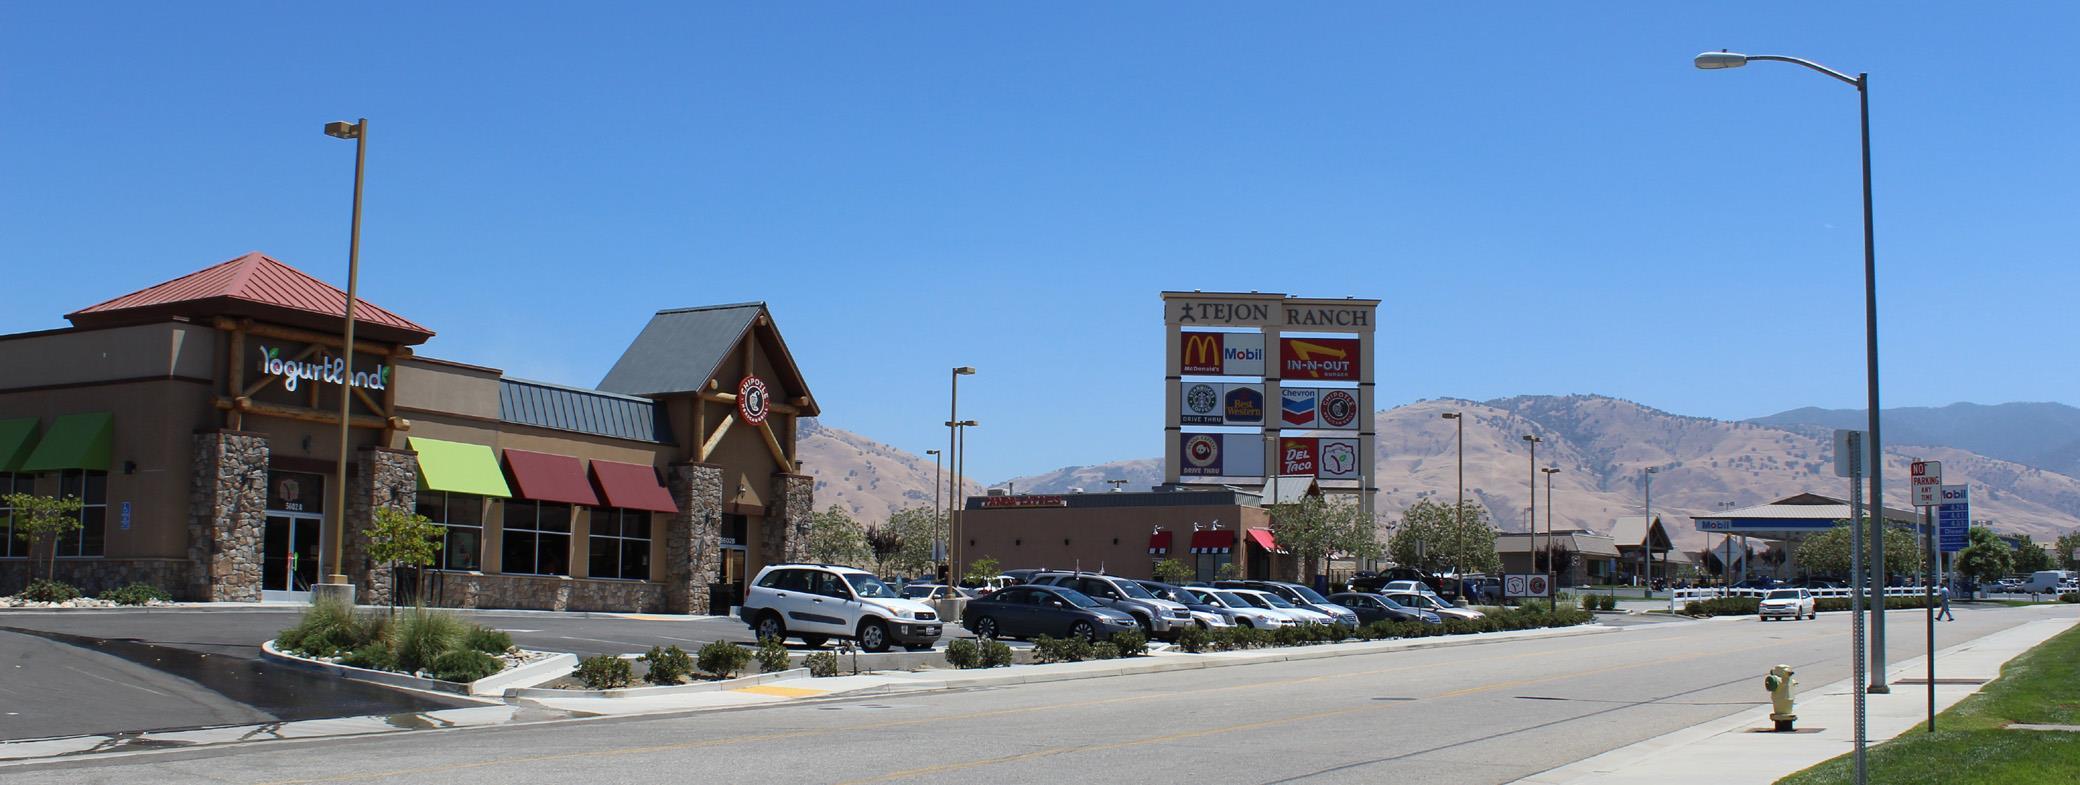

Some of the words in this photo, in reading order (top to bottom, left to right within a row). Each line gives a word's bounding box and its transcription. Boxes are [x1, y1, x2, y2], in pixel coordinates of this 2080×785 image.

[1197, 303, 1269, 323] TEJON
[1286, 308, 1368, 327] RANCH
[1224, 348, 1262, 360] Mobil
[1287, 360, 1350, 371] IN-N-OUT
[741, 378, 769, 400] CHIPOTLE
[1281, 389, 1315, 397] Chevron
[1234, 399, 1253, 408] Best
[1322, 392, 1355, 406] CHIPOTLE
[1226, 406, 1260, 416] Western
[1286, 449, 1310, 461] DEL
[1285, 461, 1312, 474] TACO
[1913, 463, 1924, 475] NO
[1913, 476, 1940, 486] PARKING
[1701, 520, 1729, 530] Mobil
